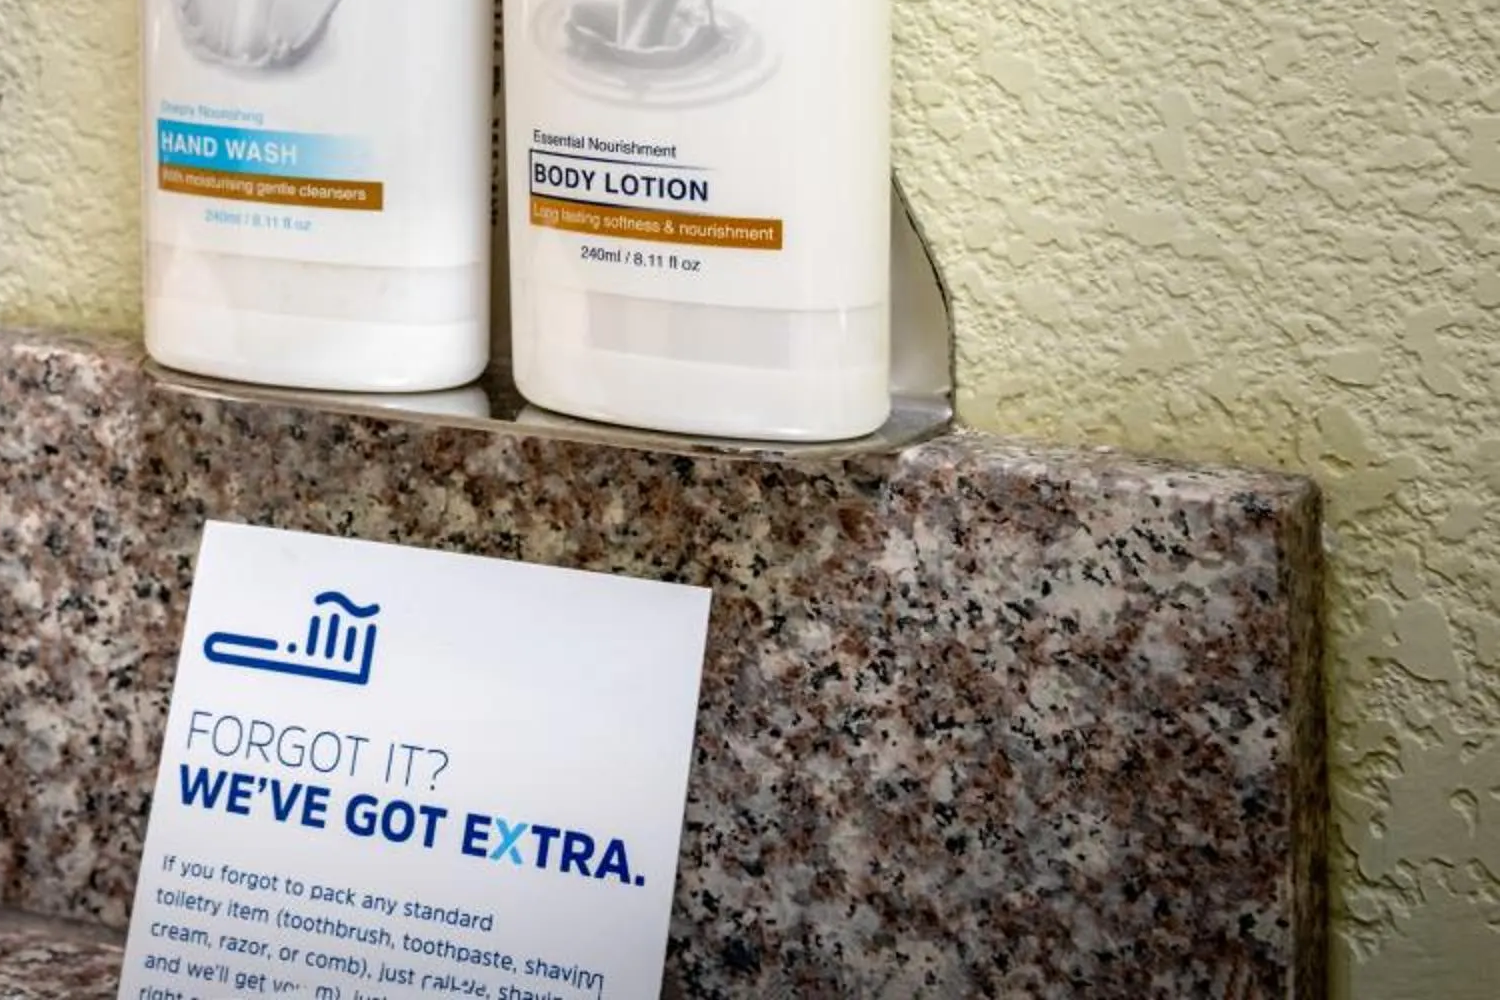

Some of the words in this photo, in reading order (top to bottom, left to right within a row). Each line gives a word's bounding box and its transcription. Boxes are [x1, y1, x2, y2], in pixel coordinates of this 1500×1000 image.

[161, 130, 218, 158] HAND
[225, 138, 298, 165] WASH
[533, 129, 586, 149] Essential
[588, 137, 678, 159] Nourishment
[257, 179, 296, 197] gentle
[299, 183, 367, 201] cleansers
[534, 163, 596, 191] BODY
[605, 173, 709, 202] LOTION
[534, 203, 560, 224] Long
[562, 208, 601, 230] lasting
[604, 213, 661, 234] softness
[663, 221, 675, 235] &
[679, 222, 774, 242] nourishment
[580, 245, 621, 263] 240ml
[633, 252, 664, 269] 8.11
[669, 255, 678, 270] fl
[681, 258, 701, 272] oz
[187, 710, 370, 776] FORGOT
[385, 743, 449, 791] IT?
[180, 764, 331, 829] WE'VE
[345, 793, 448, 848] GOT
[461, 813, 645, 887] EXTRA.
[162, 855, 177, 872] If
[180, 861, 214, 879] you
[221, 865, 279, 891] forgot
[285, 877, 305, 896] to
[310, 884, 356, 906] pack
[361, 894, 398, 916] any
[404, 901, 495, 932] standard
[156, 887, 222, 917] toiletry
[227, 899, 270, 923] item
[276, 907, 395, 950] (toothbrush,
[403, 933, 517, 974] toothpaste,
[150, 921, 212, 949] cream,
[219, 934, 271, 960] razor,
[279, 946, 300, 962] or
[377, 962, 416, 985] just
[144, 954, 182, 974] and
[187, 961, 229, 983] we'll
[235, 972, 267, 993] get
